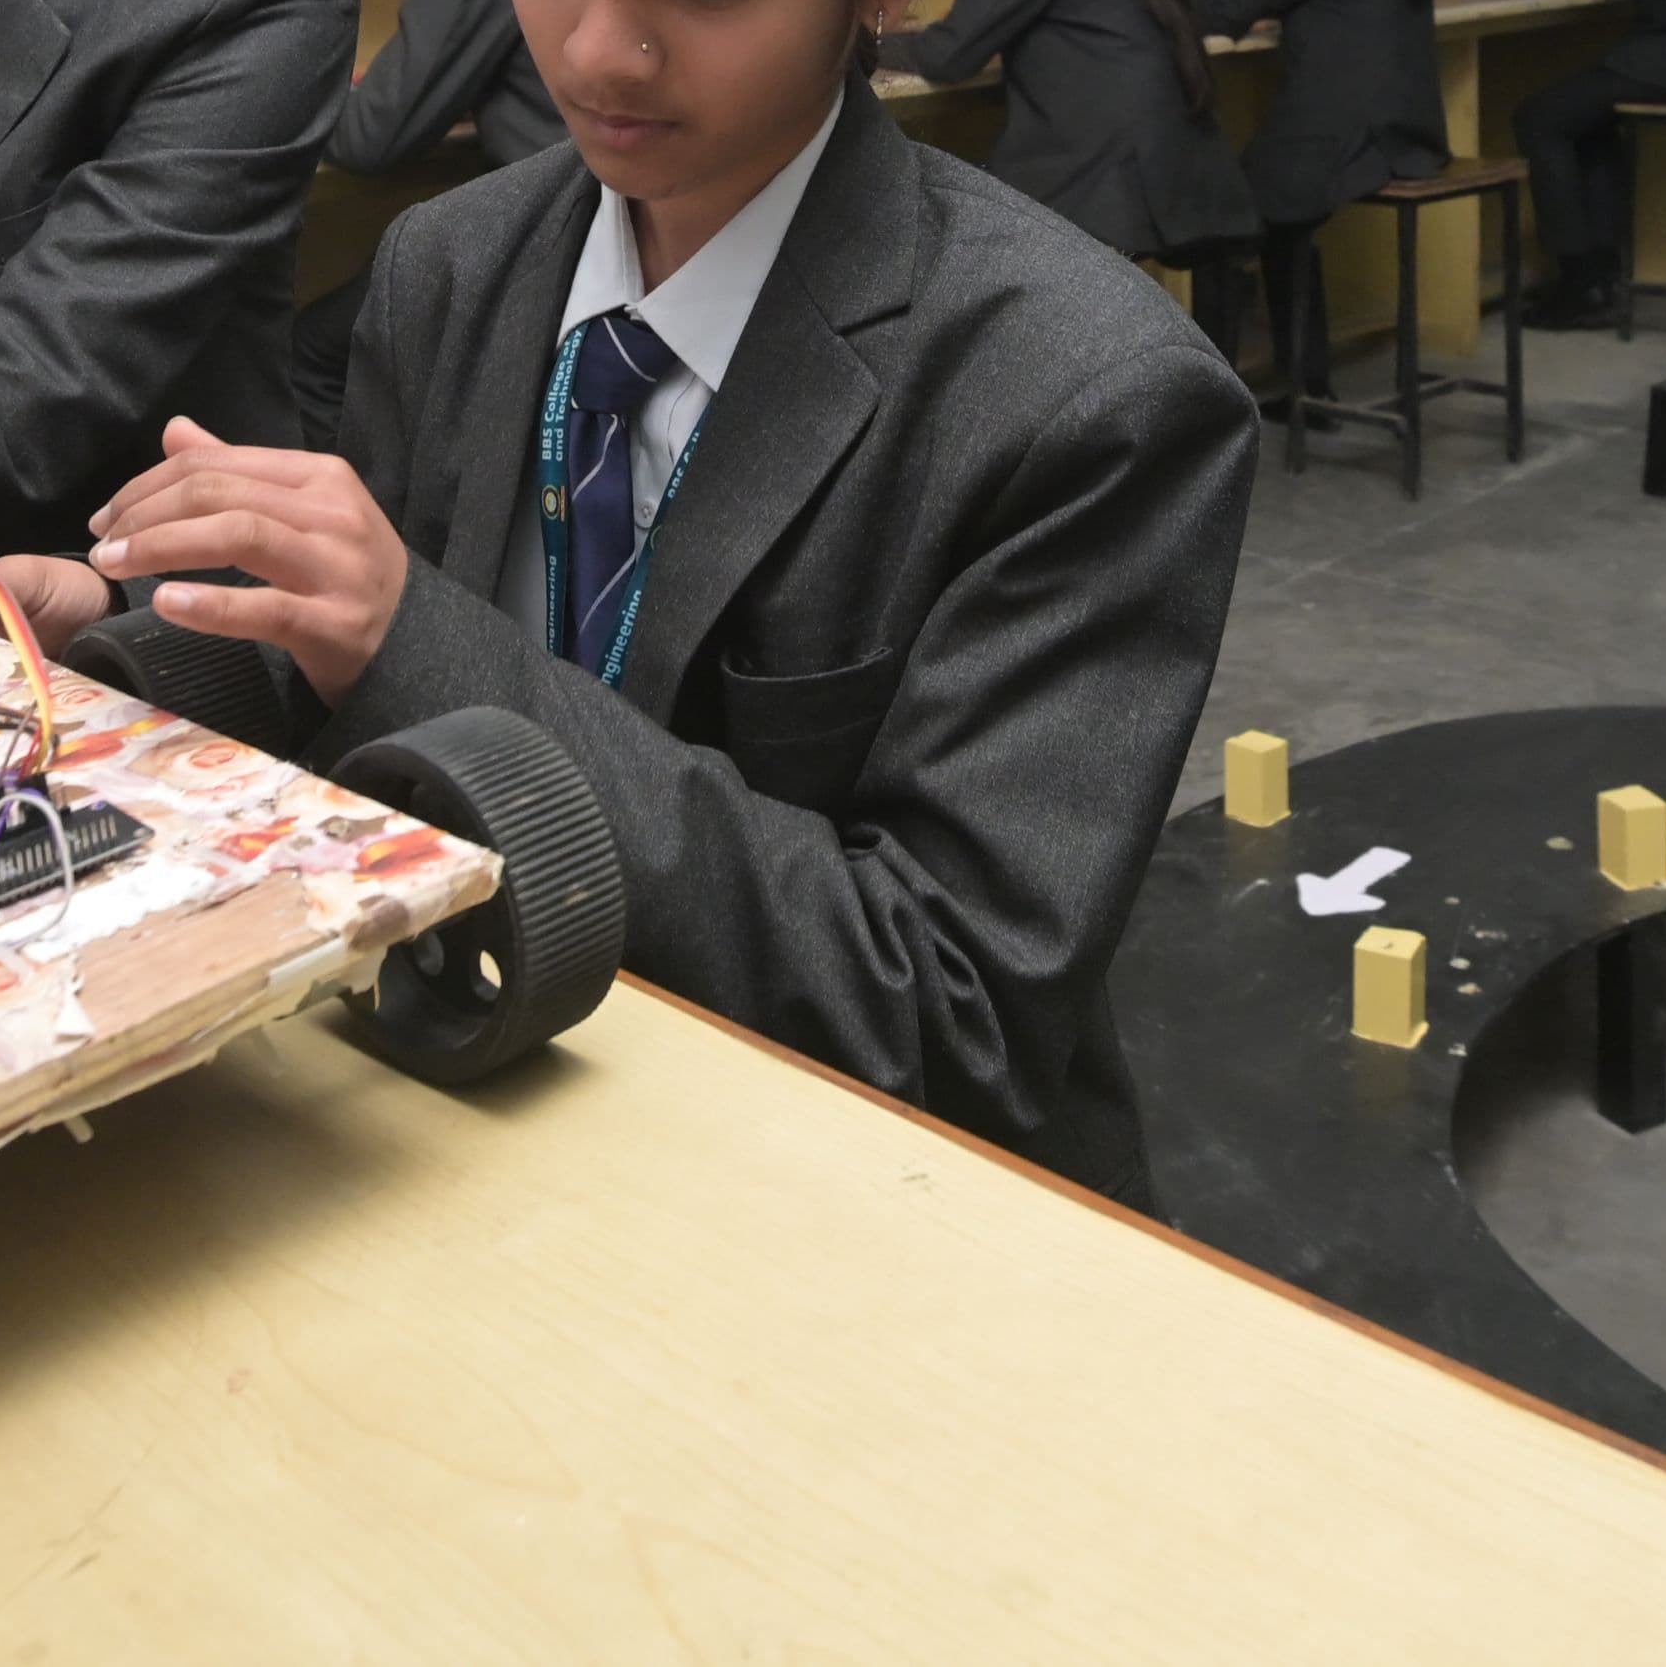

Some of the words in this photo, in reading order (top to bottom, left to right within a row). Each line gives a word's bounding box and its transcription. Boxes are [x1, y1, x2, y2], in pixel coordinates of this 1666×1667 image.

[544, 362, 566, 423] College
[555, 329, 583, 423] Technology
[541, 428, 553, 461] BBS
[555, 427, 564, 462] and
[548, 555, 558, 656] ngineering
[601, 589, 642, 685] ngineerin
